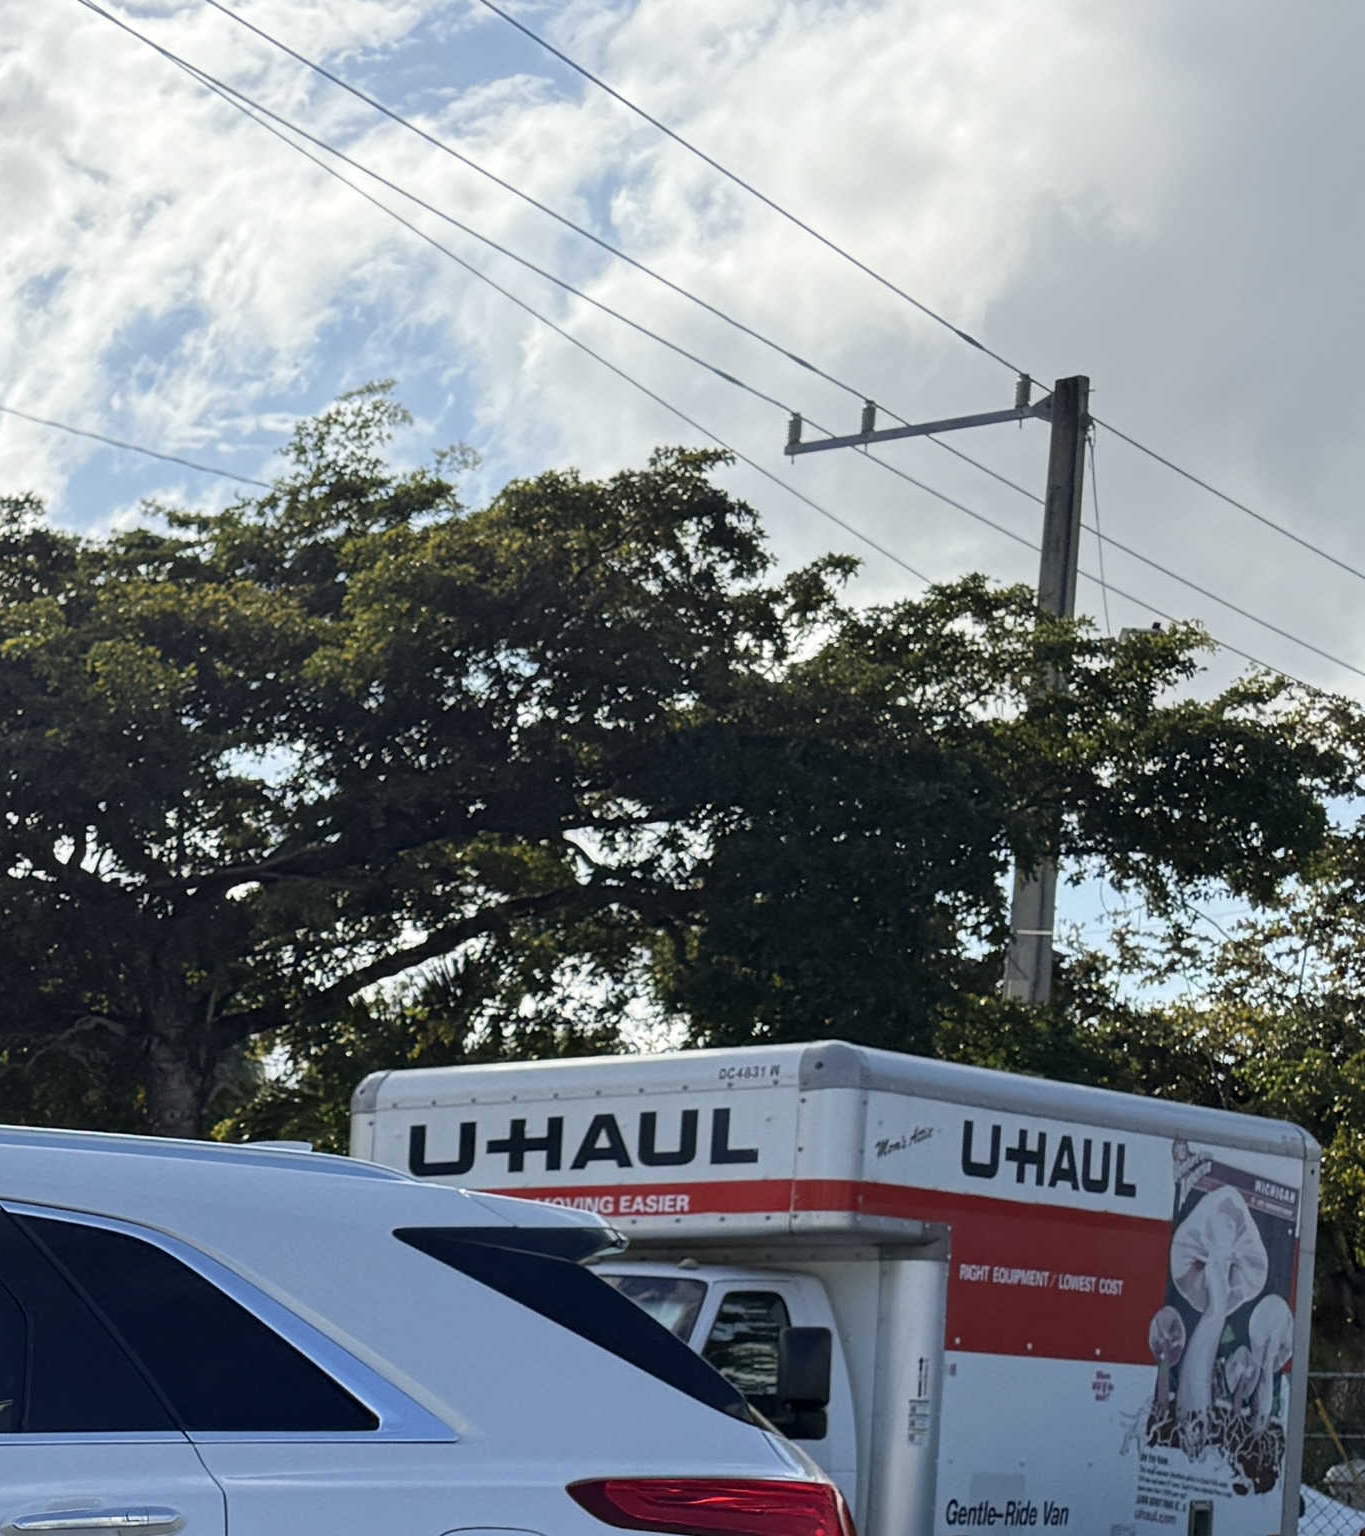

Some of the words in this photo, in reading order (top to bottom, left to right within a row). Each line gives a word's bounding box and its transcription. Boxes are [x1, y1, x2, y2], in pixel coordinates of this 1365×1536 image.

[409, 1108, 759, 1177] U-HAUL
[961, 1119, 1137, 1198] U-HAUL
[619, 1195, 690, 1213] EASIER
[959, 1264, 990, 1282] RIGHT
[992, 1266, 1050, 1288] EQUIPMENT
[1058, 1273, 1098, 1293] LOWEST
[1098, 1278, 1124, 1296] COST
[946, 1498, 1038, 1526] Gentle-Ride
[1043, 1500, 1069, 1526] Van
